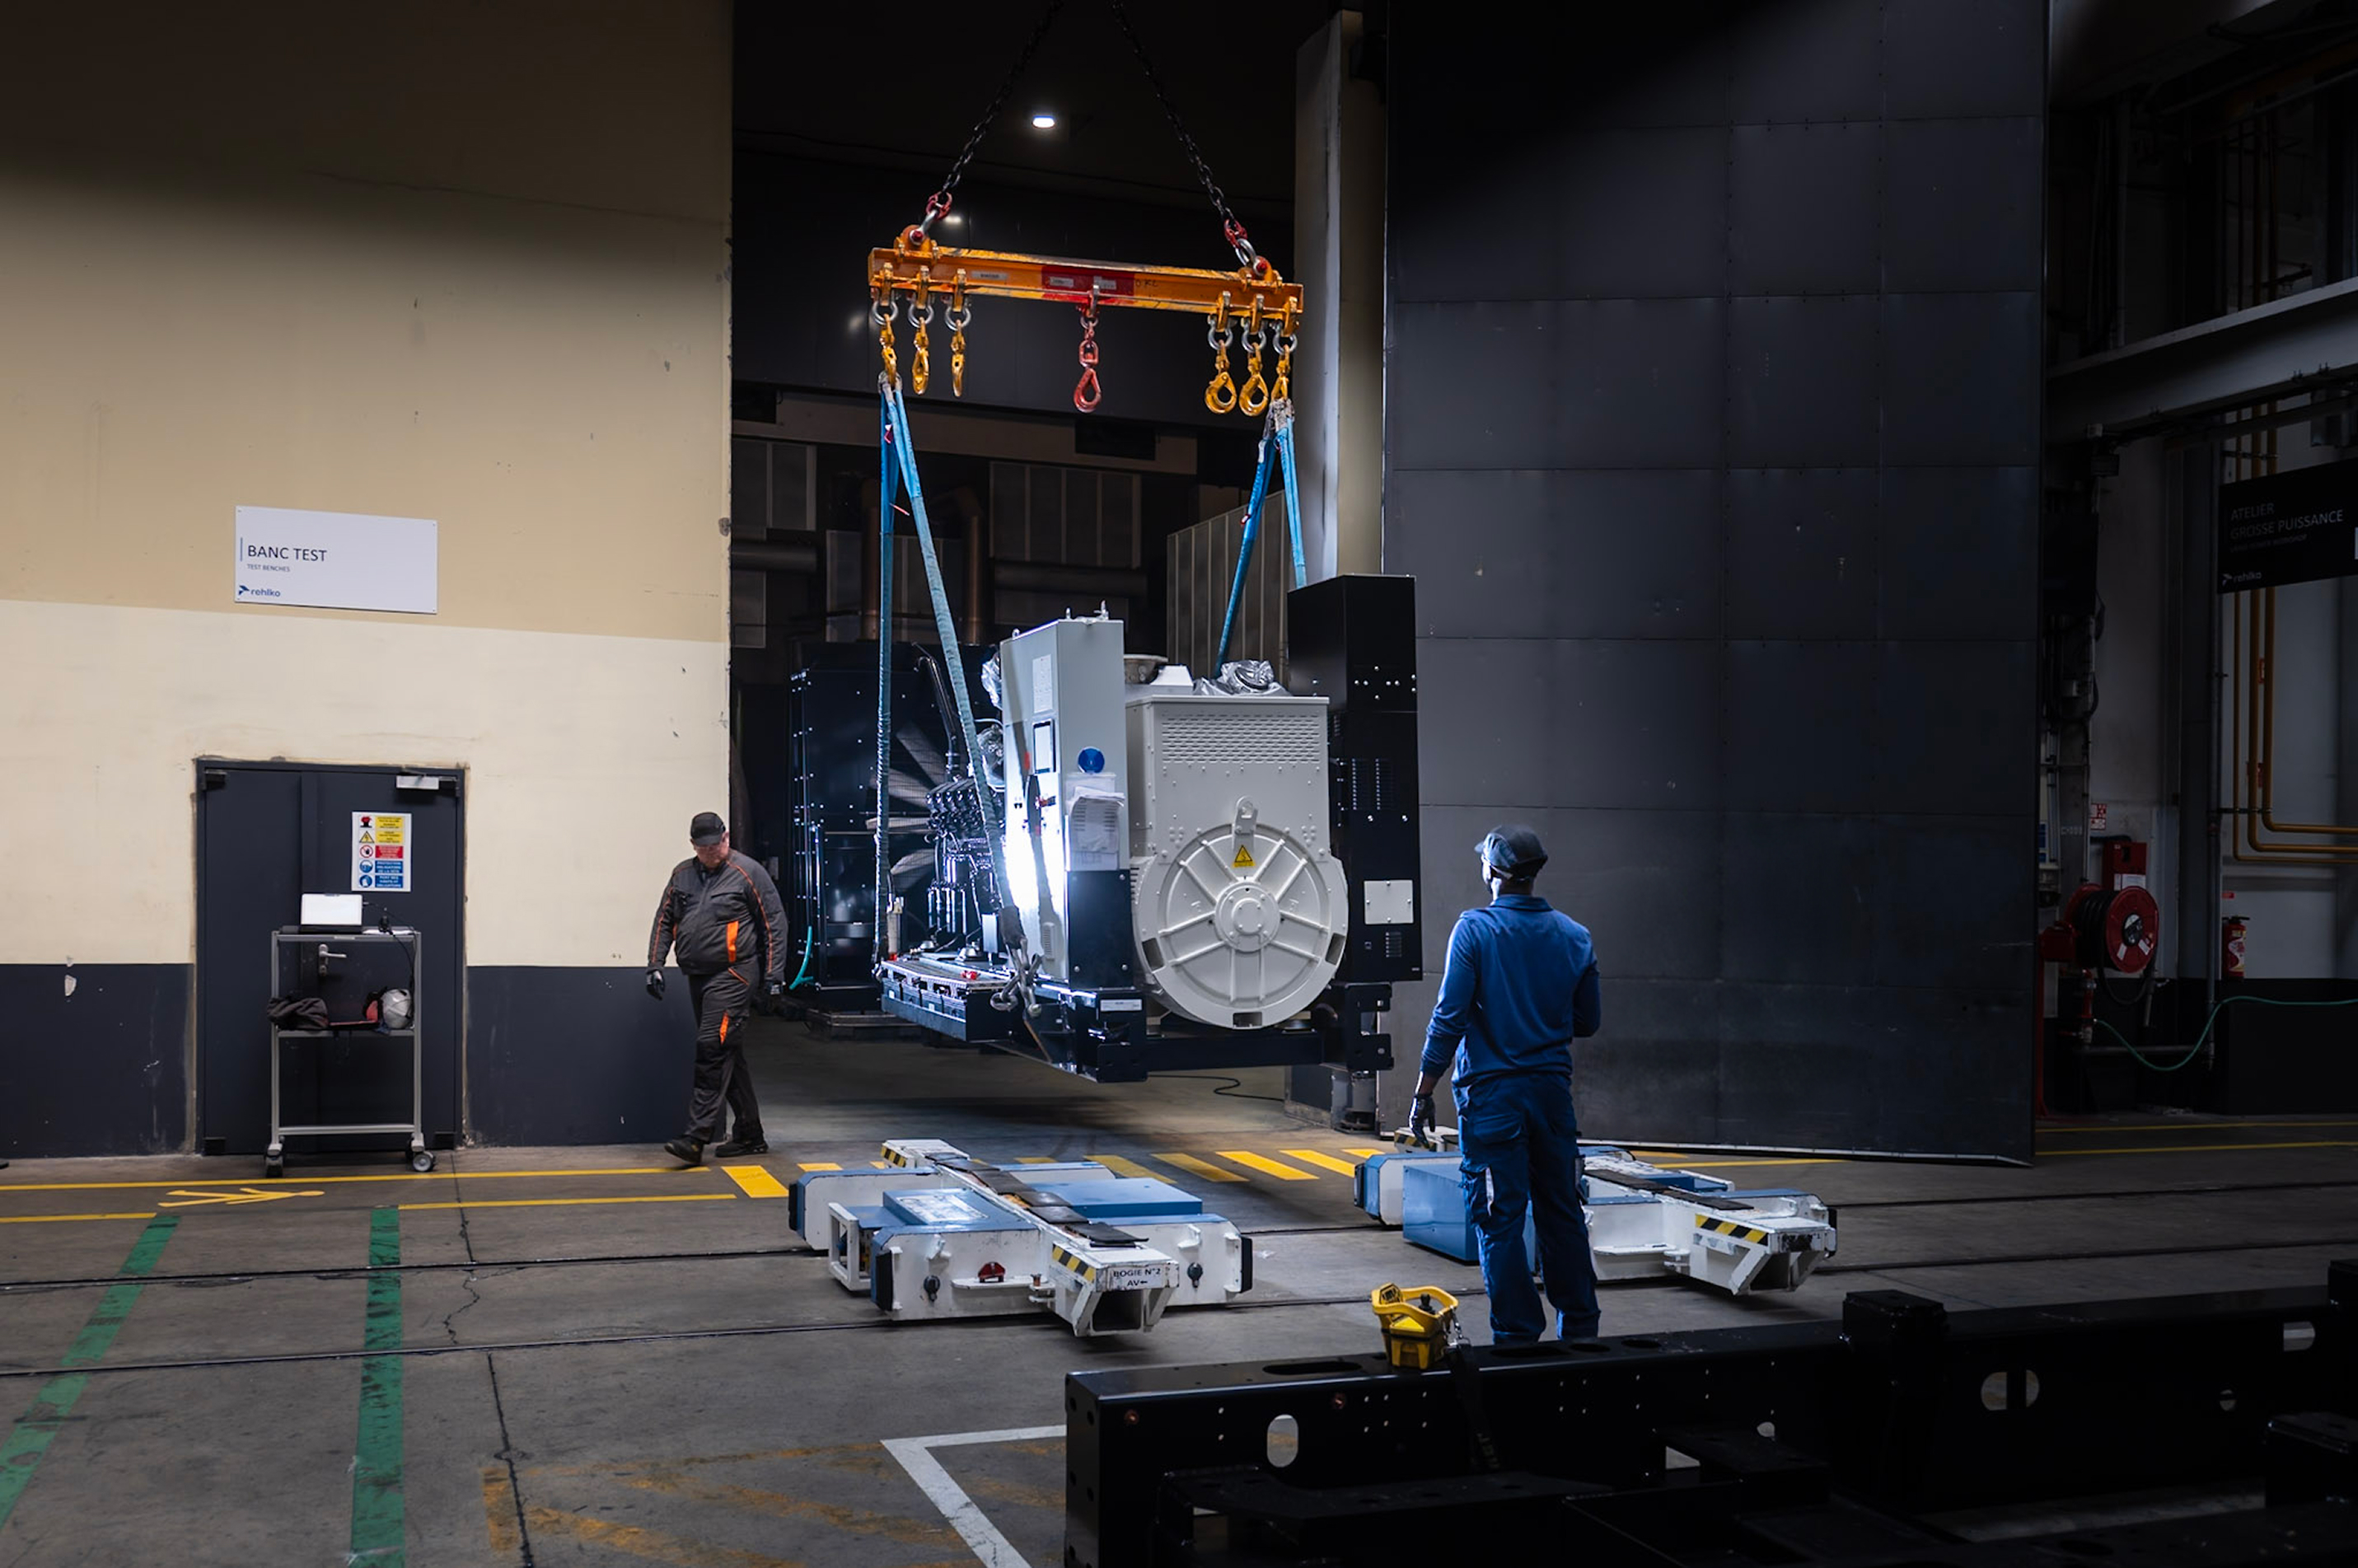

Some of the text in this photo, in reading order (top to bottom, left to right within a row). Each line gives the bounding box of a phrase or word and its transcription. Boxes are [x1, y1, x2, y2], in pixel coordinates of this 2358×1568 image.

[2231, 503, 2275, 520] ATELIER
[2231, 509, 2344, 539] GROSSE PUISSANCE
[248, 545, 327, 562] BANC TEST
[250, 588, 281, 597] rehlko
